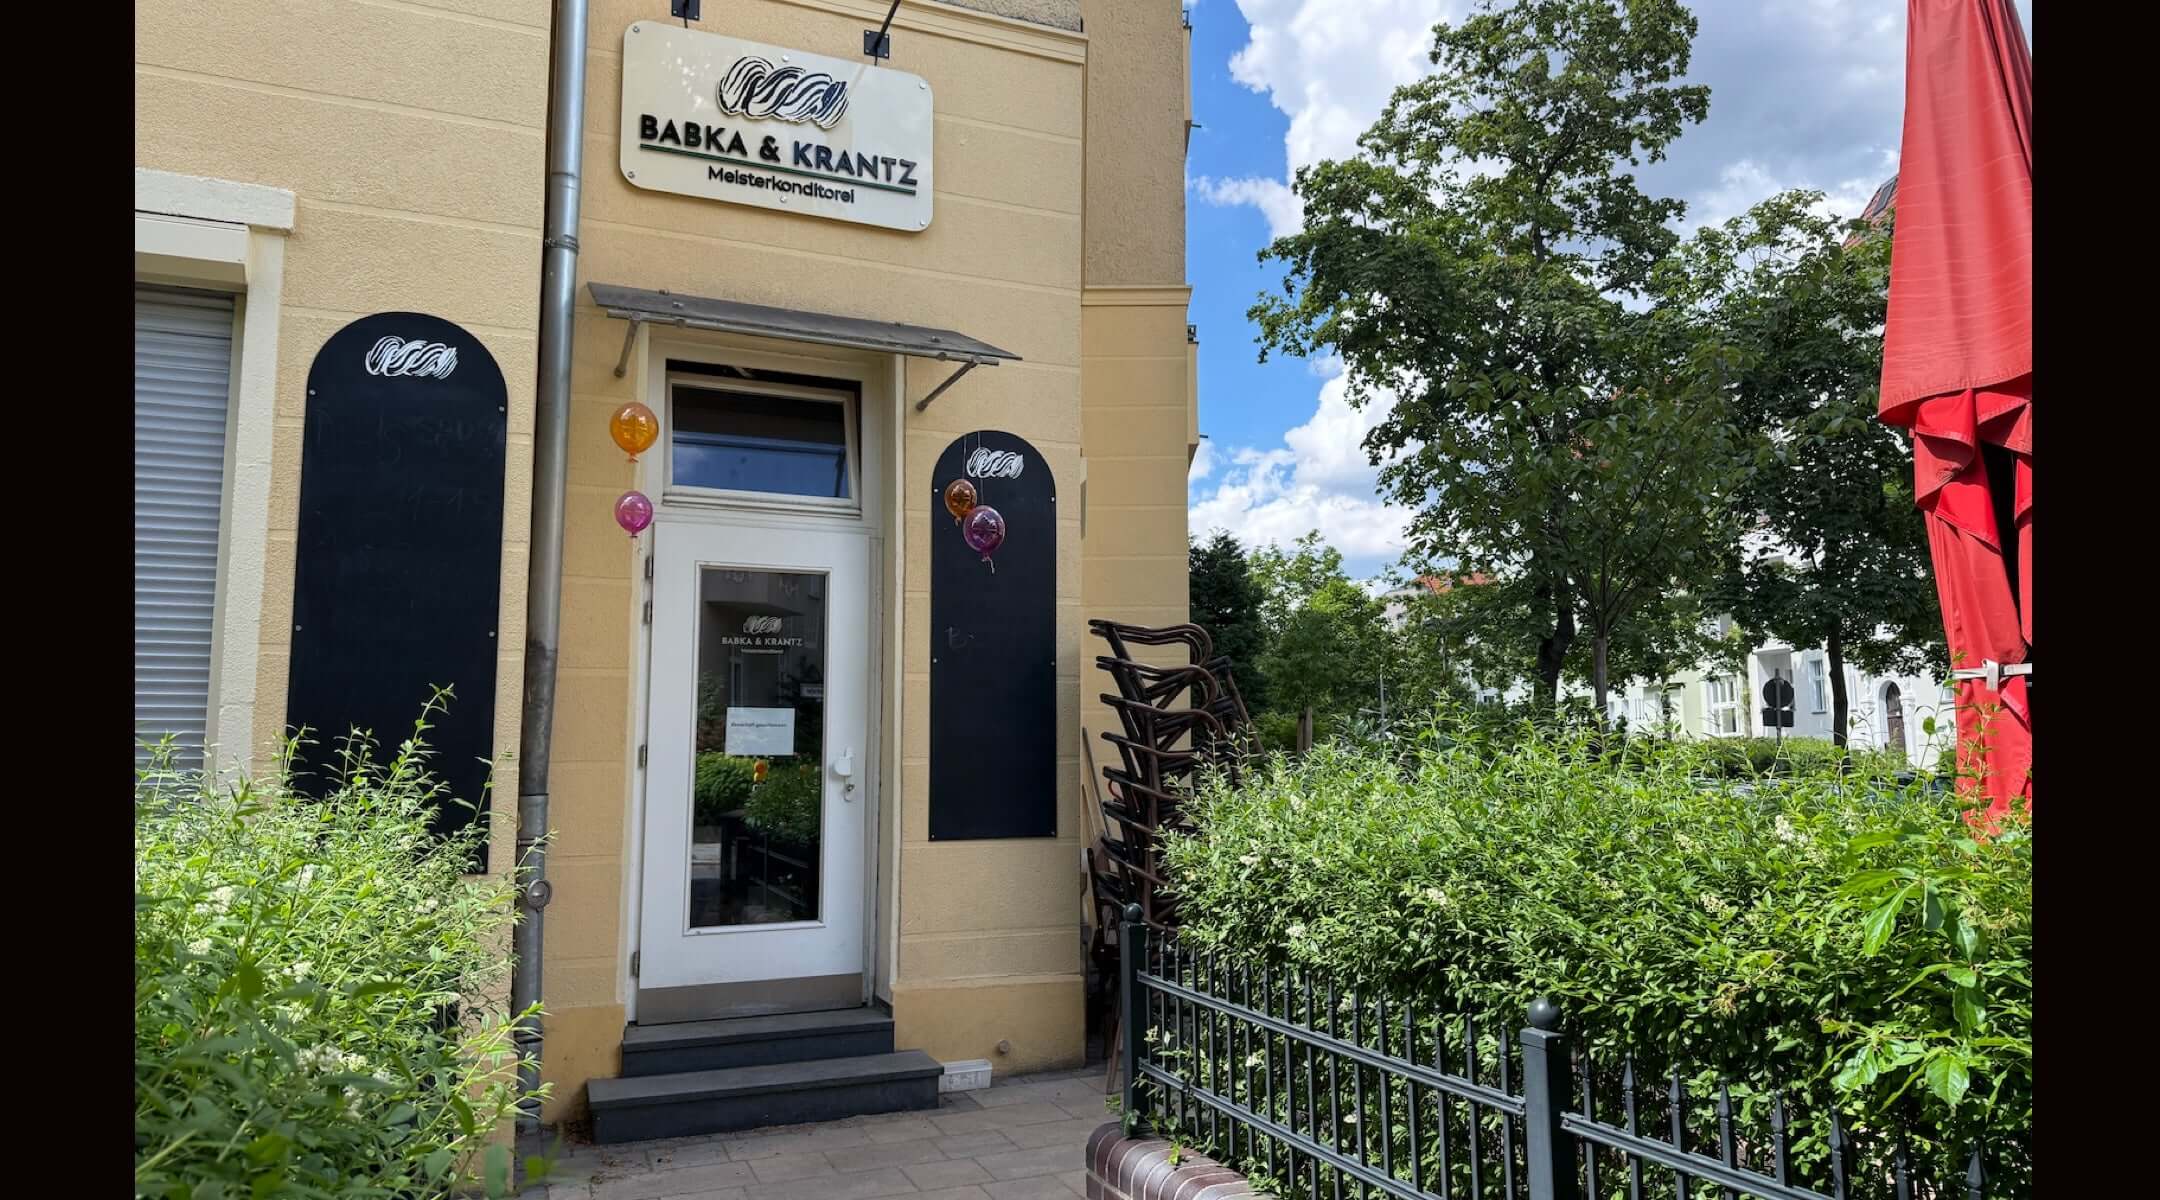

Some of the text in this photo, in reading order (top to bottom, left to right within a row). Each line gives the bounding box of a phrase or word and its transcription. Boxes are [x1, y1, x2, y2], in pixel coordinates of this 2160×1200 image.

[640, 114, 918, 186] BABKA & KRANTZ
[708, 165, 855, 204] Meisterkonditorei
[721, 636, 803, 647] BABKA & KRANTZ
